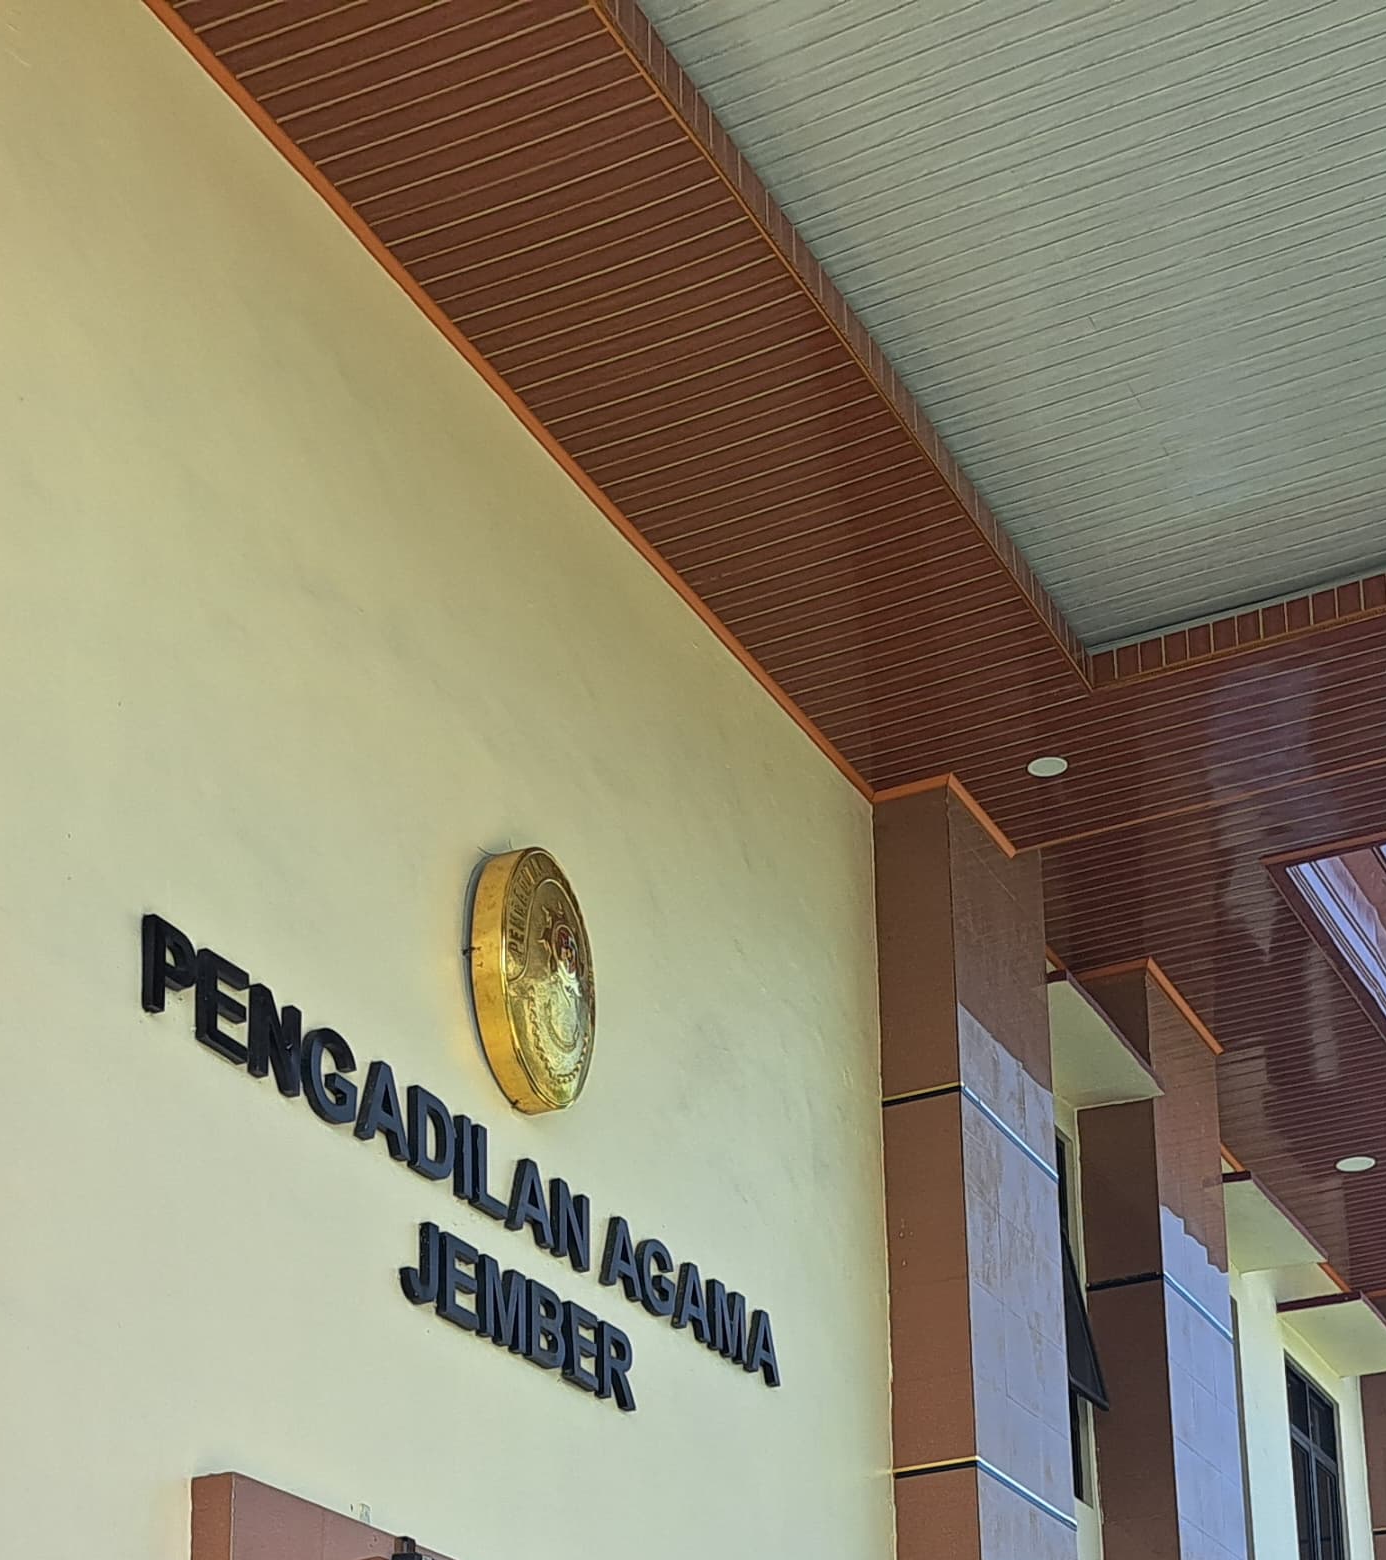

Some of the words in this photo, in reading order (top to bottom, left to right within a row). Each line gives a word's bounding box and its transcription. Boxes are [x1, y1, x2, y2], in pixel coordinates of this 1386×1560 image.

[141, 913, 590, 1272] PENGADILAN
[599, 1216, 781, 1388] AGAMA
[400, 1222, 636, 1411] JEMBER
